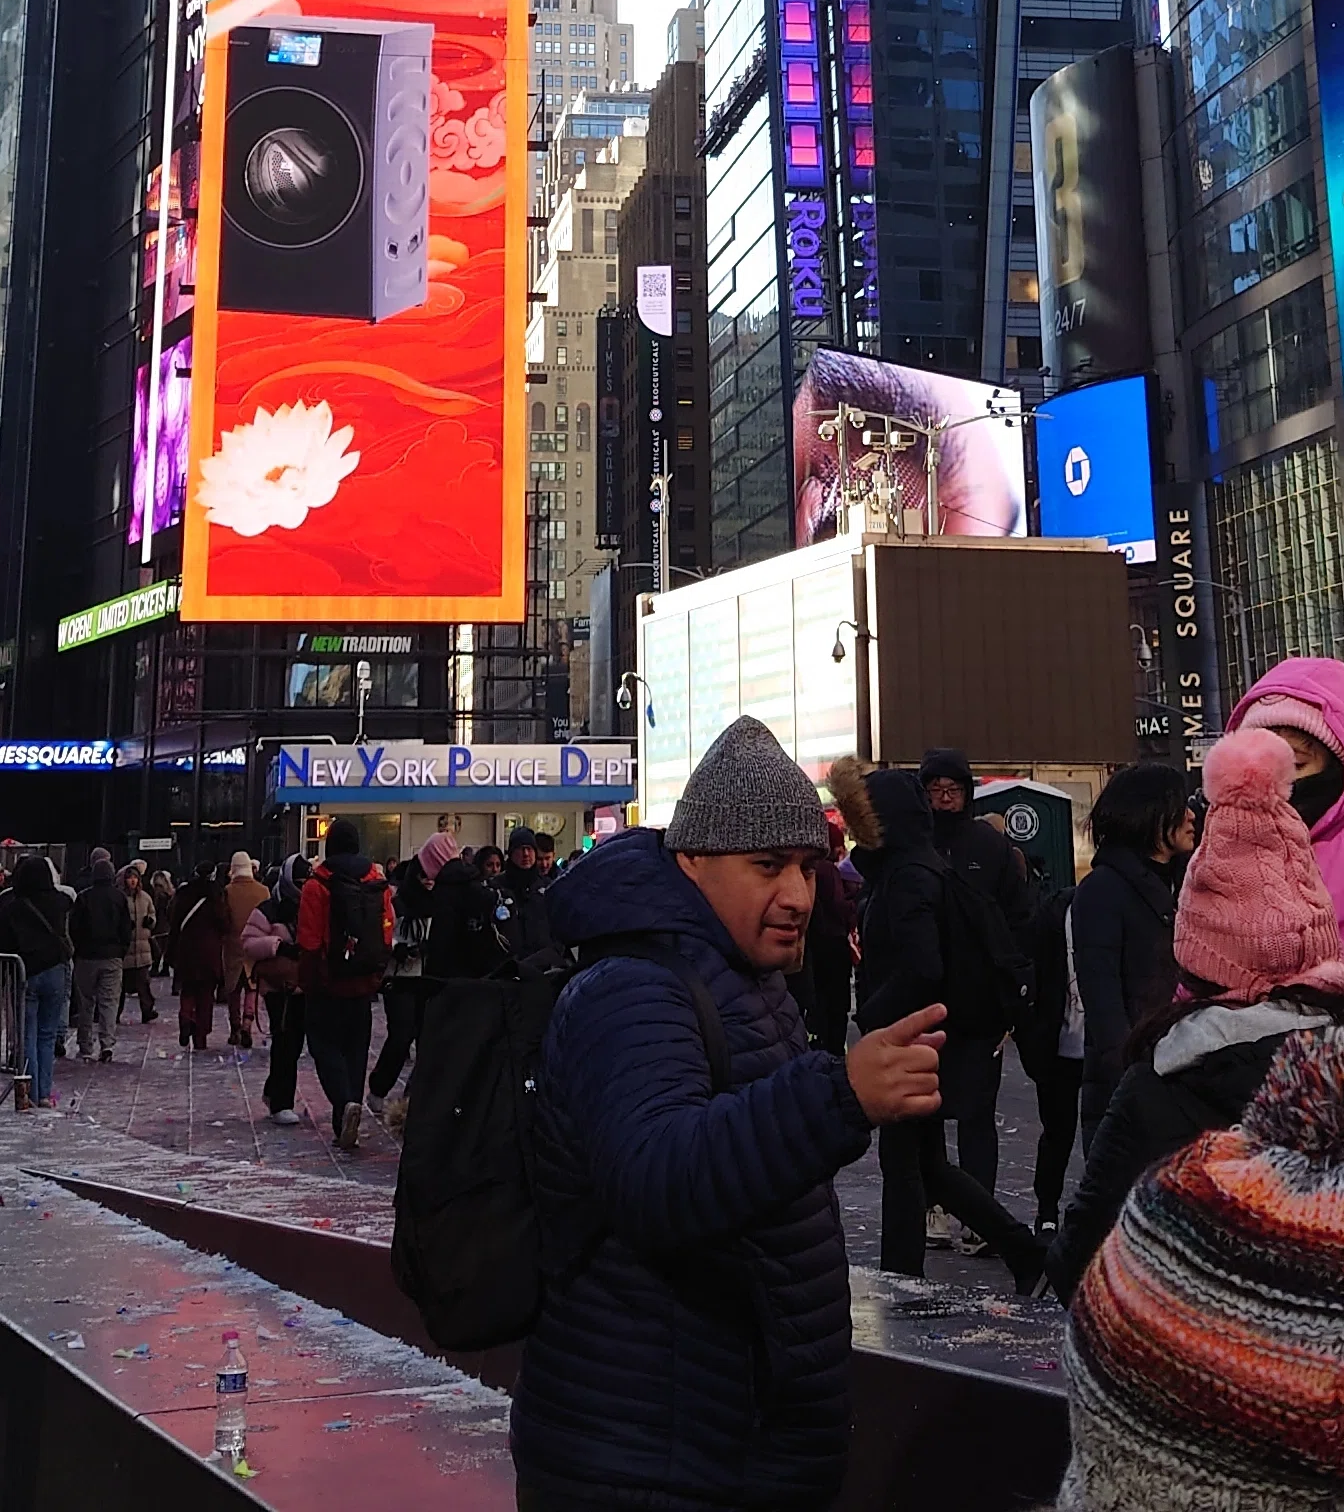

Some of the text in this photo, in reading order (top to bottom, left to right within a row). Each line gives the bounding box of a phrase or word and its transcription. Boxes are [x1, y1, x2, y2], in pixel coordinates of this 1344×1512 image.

[1055, 298, 1087, 336] 24/7
[605, 322, 614, 528] TIMES SQUARE
[68, 612, 94, 644] OPEN!
[97, 600, 130, 635] LIMITED
[129, 585, 167, 623] TICKETS
[1169, 509, 1198, 637] SQUARE
